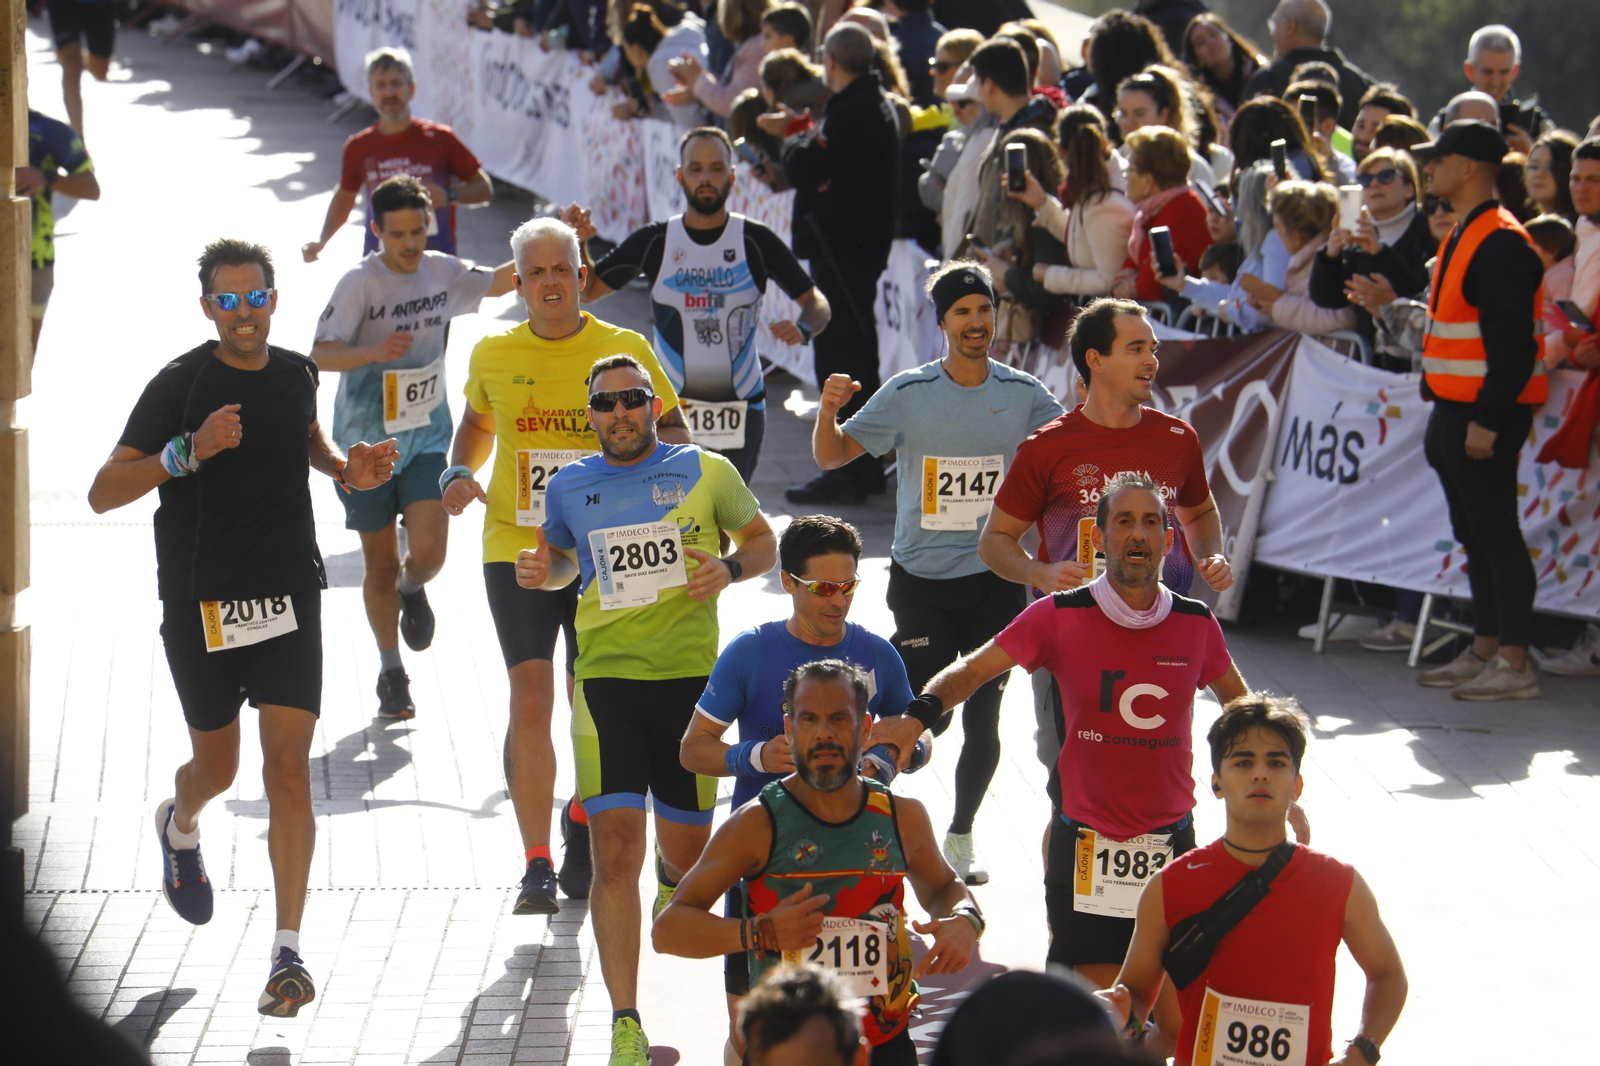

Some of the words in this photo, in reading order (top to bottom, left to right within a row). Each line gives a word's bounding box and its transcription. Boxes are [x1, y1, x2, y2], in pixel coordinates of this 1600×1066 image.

[675, 267, 734, 287] CARBALLO
[685, 289, 725, 308] bnfit
[369, 305, 386, 320] LA
[424, 316, 442, 327] TRAIL
[406, 374, 438, 402] 677
[542, 408, 588, 419] MARATÓ
[689, 409, 741, 430] 1810
[516, 417, 597, 433] SEVILLA
[540, 452, 573, 460] IMDECO
[947, 459, 979, 467] IMDECO
[938, 471, 999, 496] 2147
[1079, 487, 1100, 504] 36
[616, 527, 650, 538] IMDECO
[609, 538, 678, 572] 2803
[599, 555, 608, 580] CAJÓN
[220, 596, 287, 626] 2018
[207, 609, 217, 634] CAJÓN
[235, 621, 259, 629] FRANCISCO
[259, 616, 278, 625] CANTERO
[1081, 855, 1089, 880] CAJÓN
[1097, 849, 1166, 879] 1983
[820, 919, 855, 929] MDECO
[807, 934, 880, 968] 2118
[1233, 1003, 1276, 1017] IMDECO
[1201, 1021, 1211, 1052] CAJÓN
[1226, 1021, 1291, 1061] 986
[1222, 1054, 1243, 1064] MARCOS
